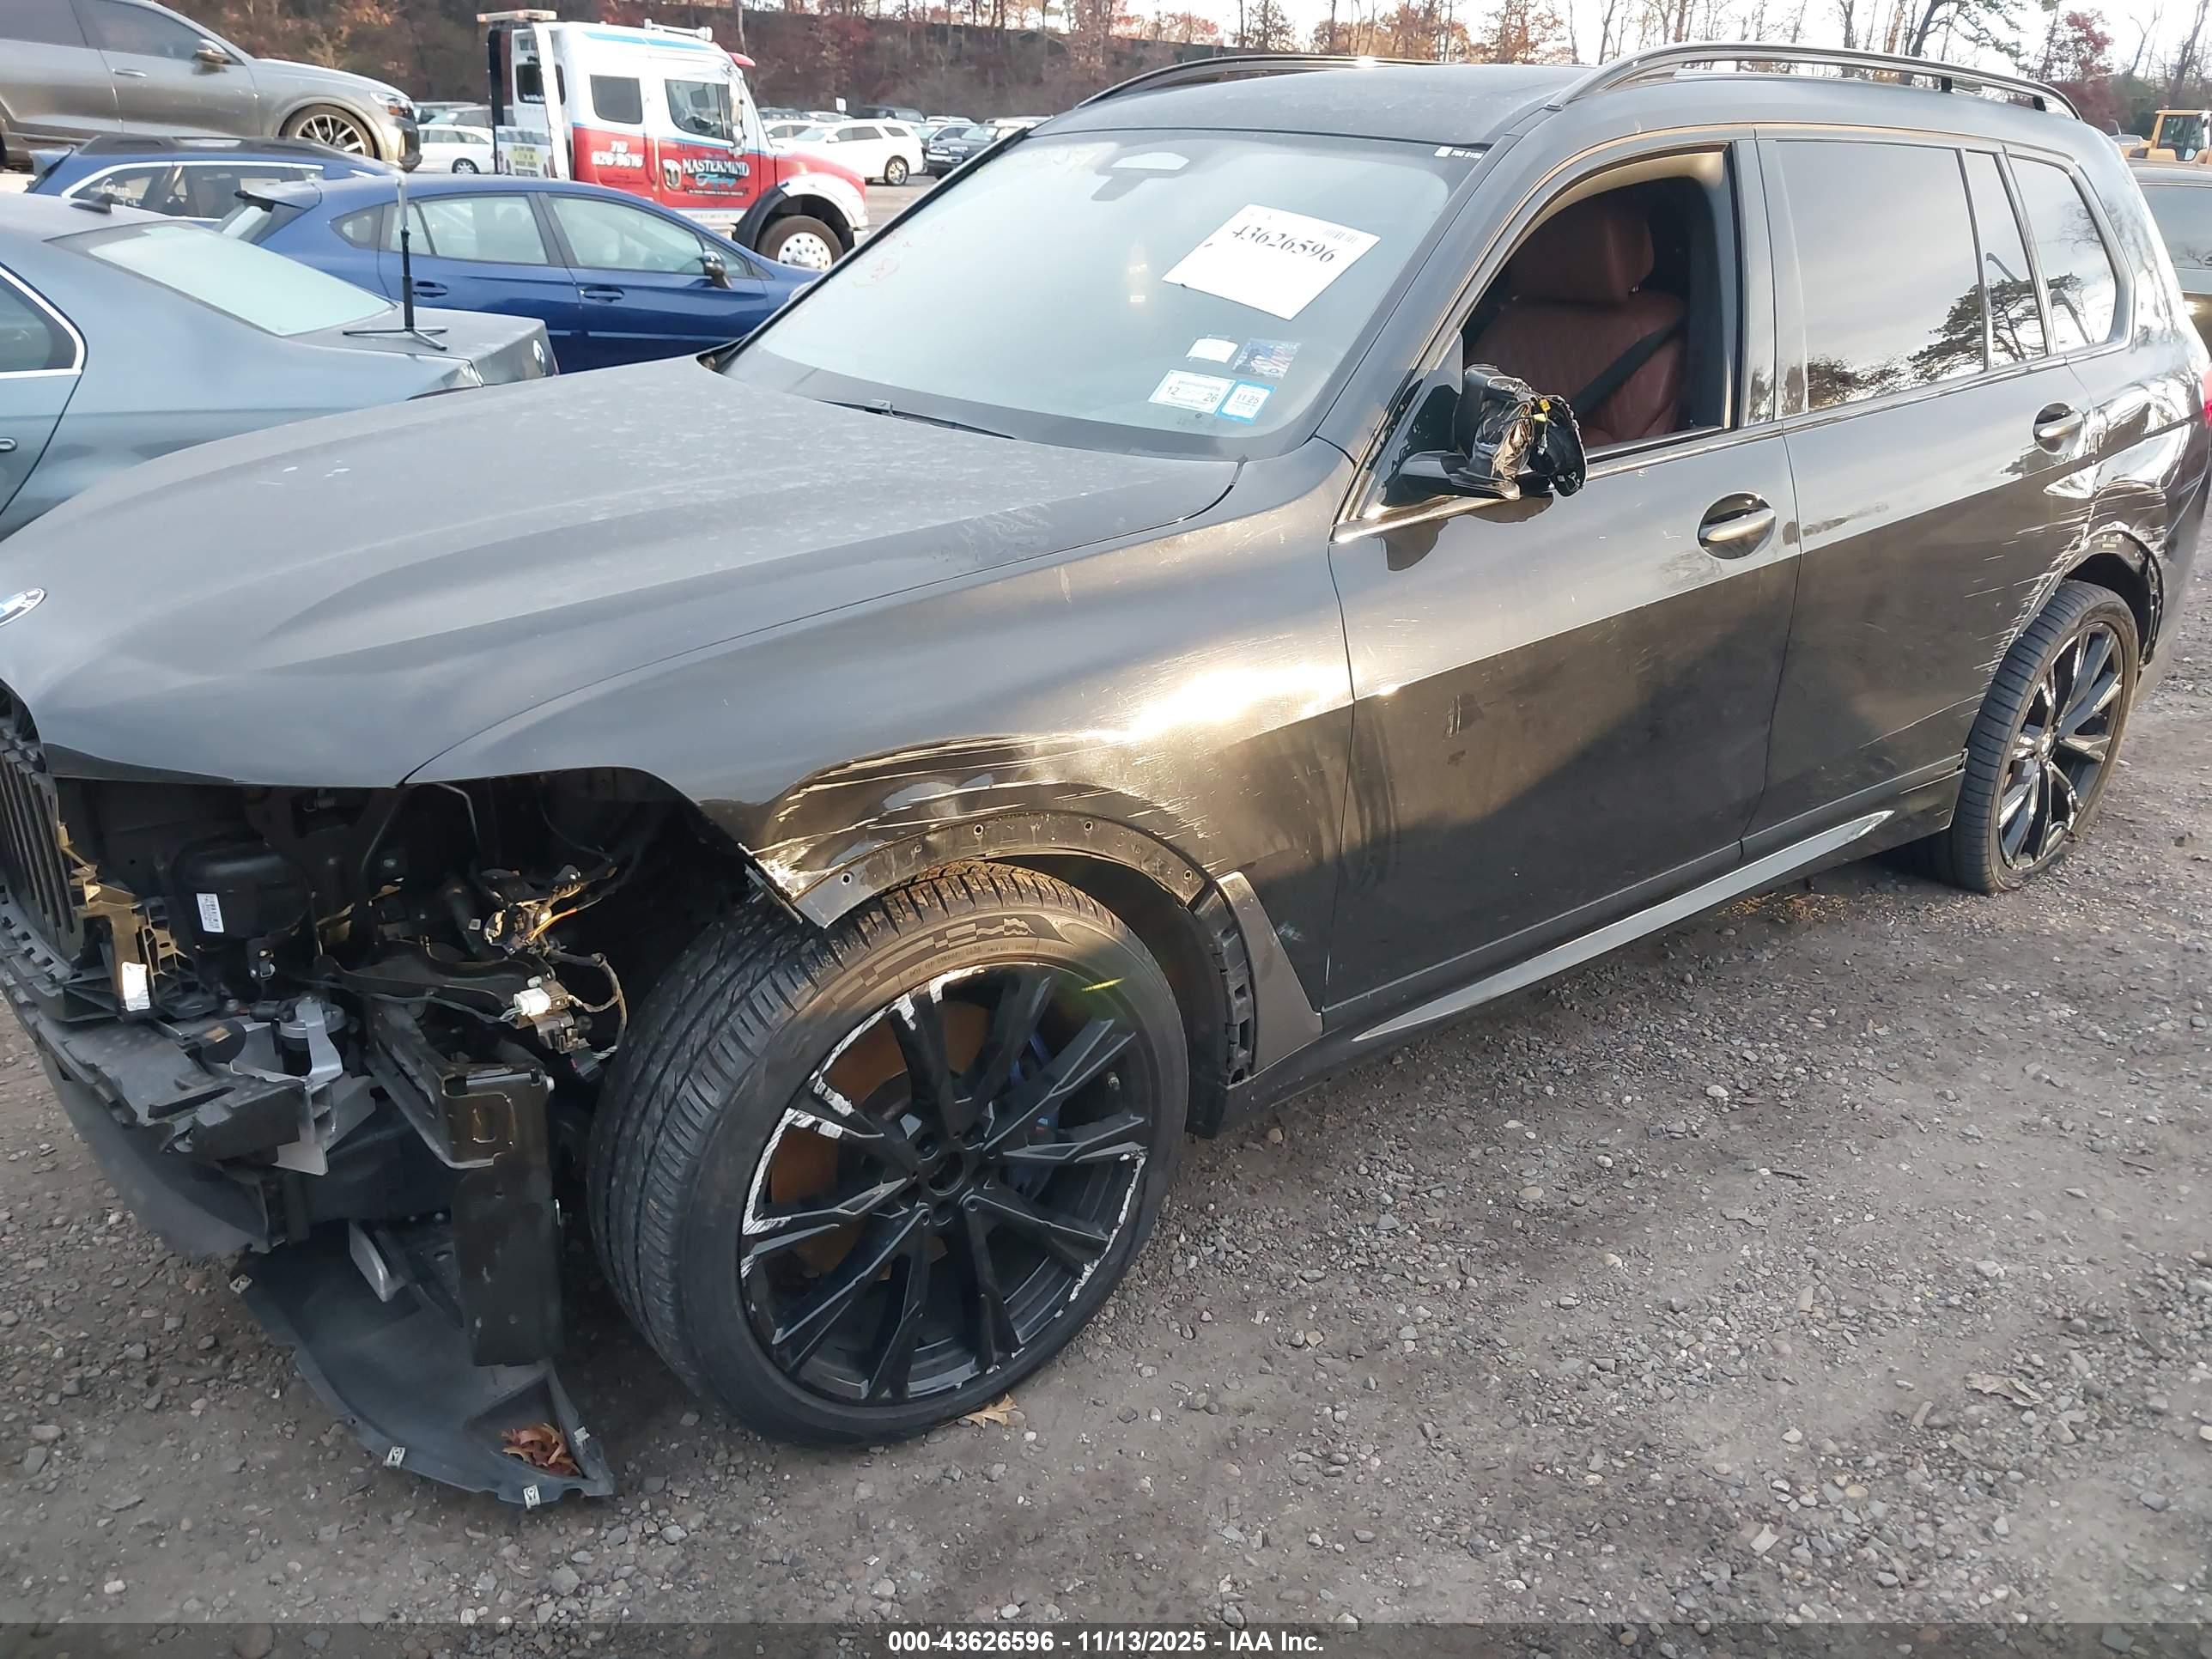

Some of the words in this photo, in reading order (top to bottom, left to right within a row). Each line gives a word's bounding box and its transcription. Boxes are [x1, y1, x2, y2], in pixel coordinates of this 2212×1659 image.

[682, 158, 750, 177] MASTERMIND
[1231, 224, 1337, 263] 43626596
[1167, 385, 1181, 396] 12
[1202, 392, 1219, 403] 26
